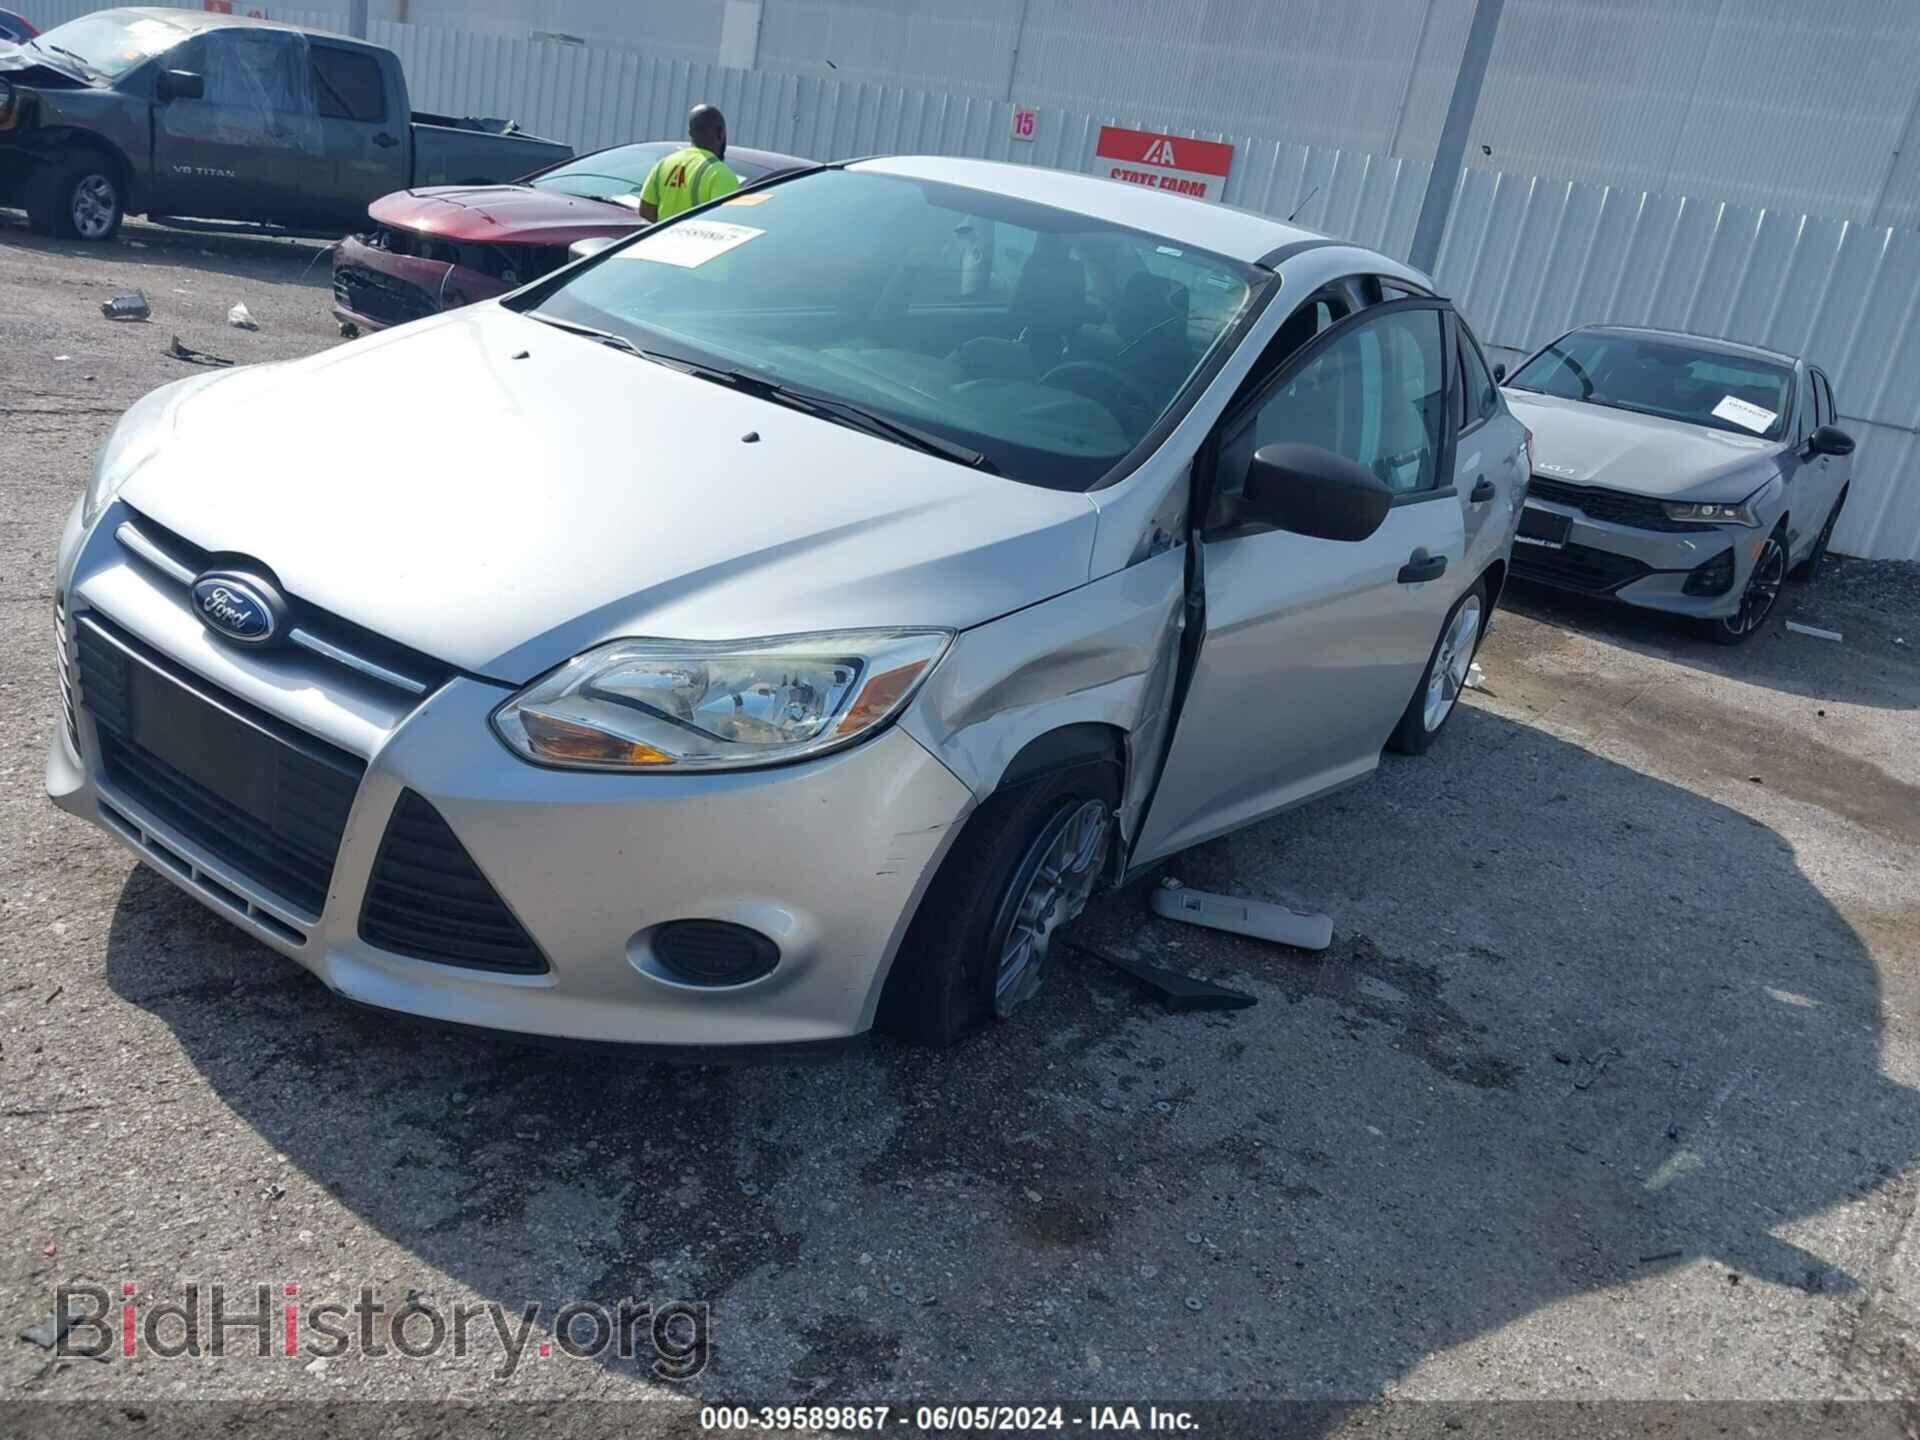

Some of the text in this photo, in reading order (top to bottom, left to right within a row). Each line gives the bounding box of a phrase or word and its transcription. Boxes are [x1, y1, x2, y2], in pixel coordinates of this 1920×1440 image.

[1015, 111, 1035, 137] 15
[195, 166, 236, 178] TITAN
[1110, 167, 1207, 198] STATE FARM
[203, 587, 252, 629] Ford
